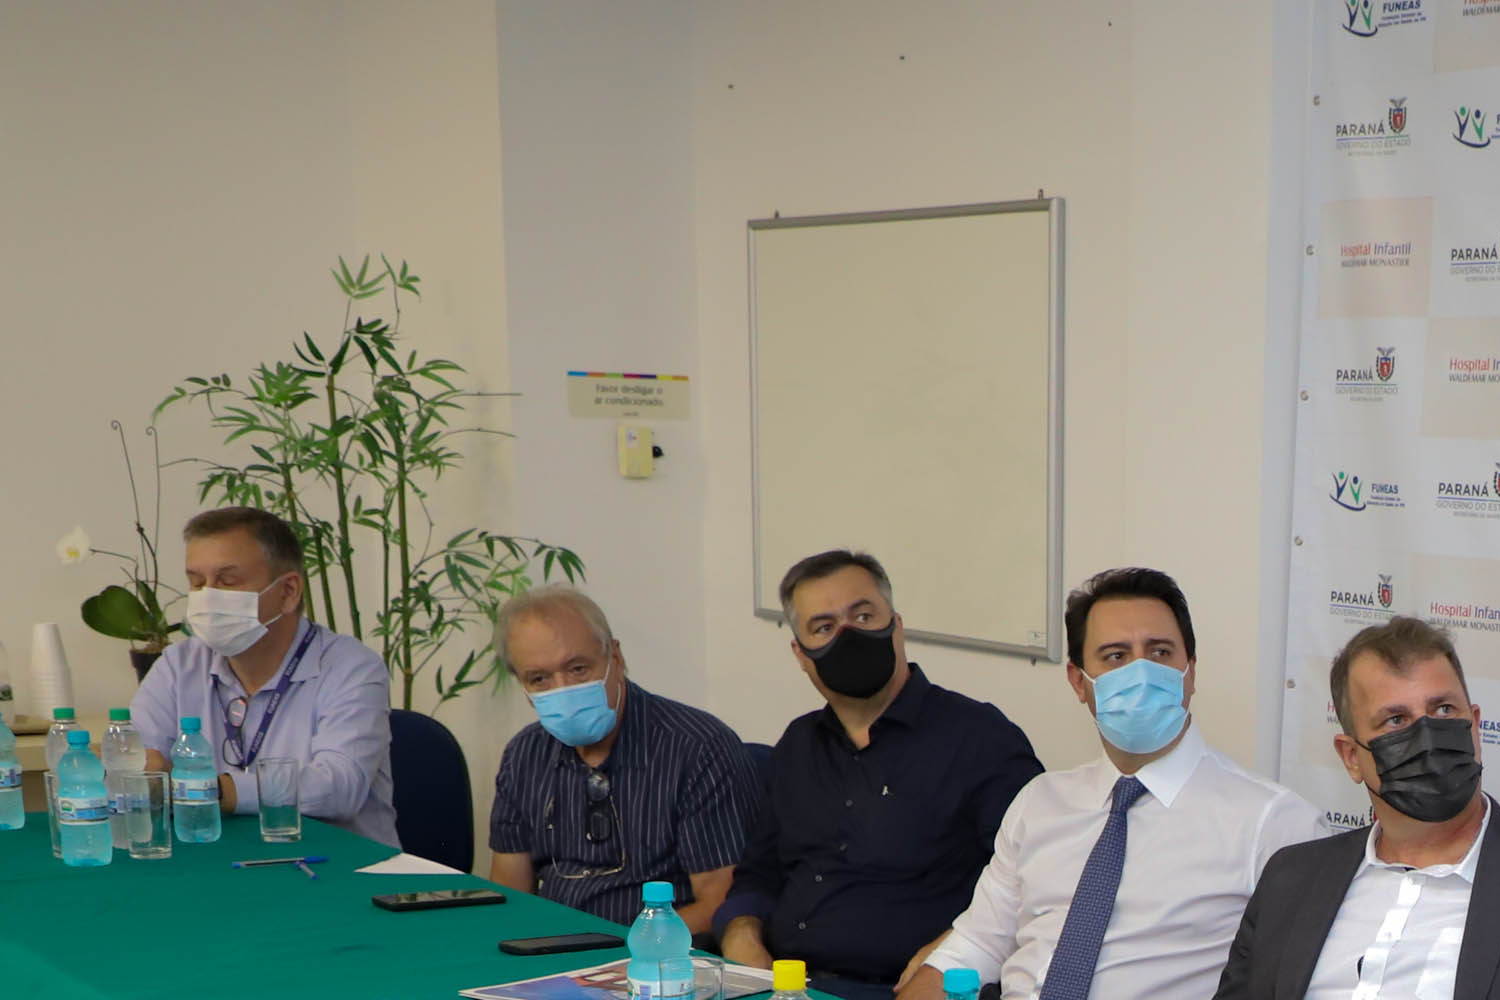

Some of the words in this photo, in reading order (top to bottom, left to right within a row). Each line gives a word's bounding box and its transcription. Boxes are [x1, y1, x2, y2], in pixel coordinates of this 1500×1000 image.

[1381, 0, 1421, 13] FUNEAS
[1336, 120, 1385, 137] PARANÁ
[1374, 242, 1411, 256] Infantil
[1450, 243, 1498, 261] PARANÁ
[1449, 357, 1490, 373] Hospital
[1335, 368, 1374, 382] PARANÁ
[1438, 481, 1489, 498] PARANÁ
[1331, 591, 1375, 606] PARANÁ
[1430, 602, 1472, 619] Hospital
[1326, 811, 1367, 828] ARANÁ
